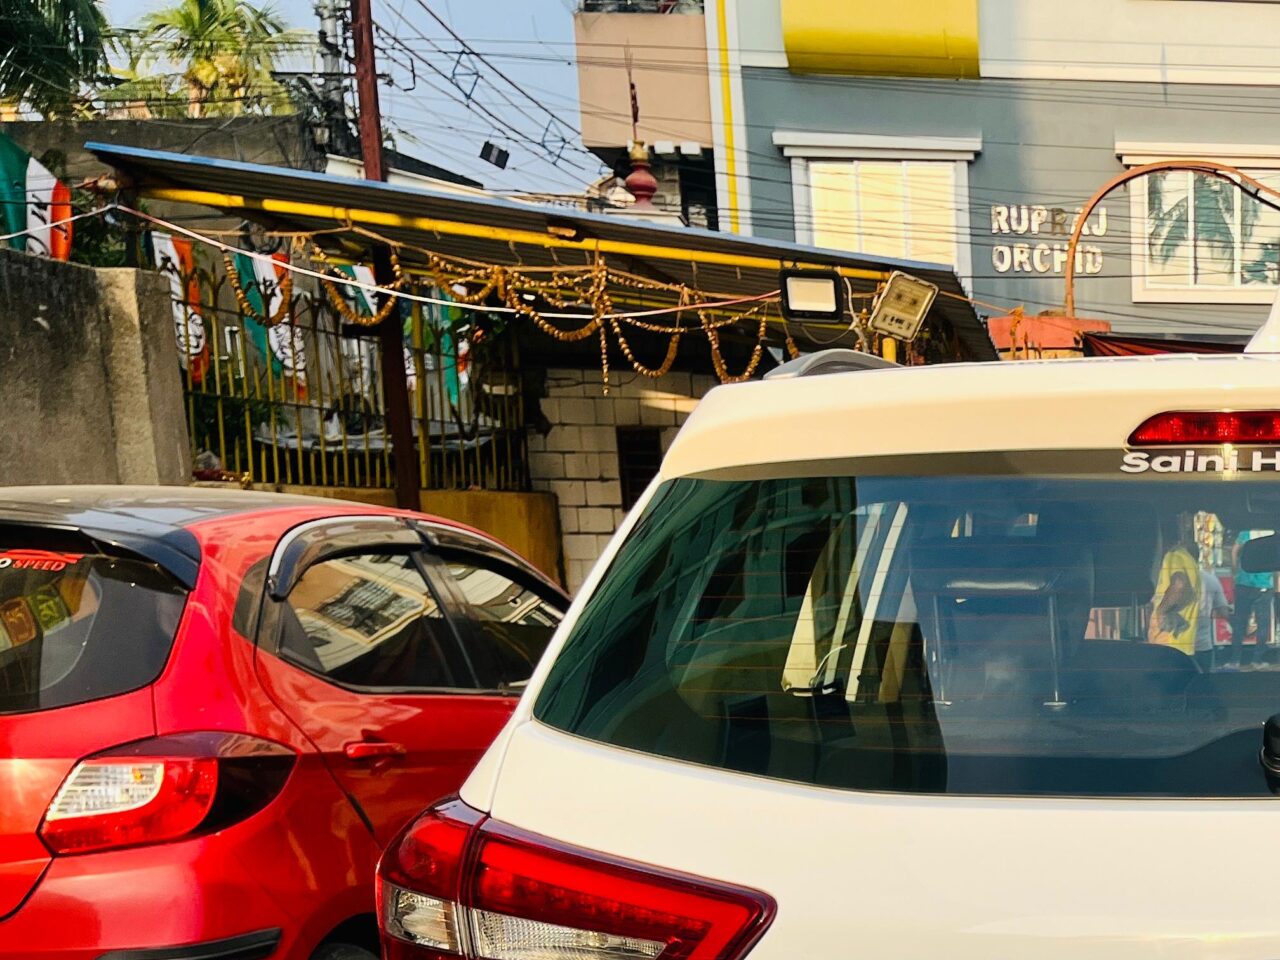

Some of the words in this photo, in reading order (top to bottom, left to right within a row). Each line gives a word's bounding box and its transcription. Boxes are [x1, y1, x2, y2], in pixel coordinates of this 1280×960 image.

[991, 204, 1107, 236] RUPRAJ
[991, 244, 1103, 274] ORCHID
[1120, 450, 1239, 473] Saini
[12, 559, 67, 572] SPEED
